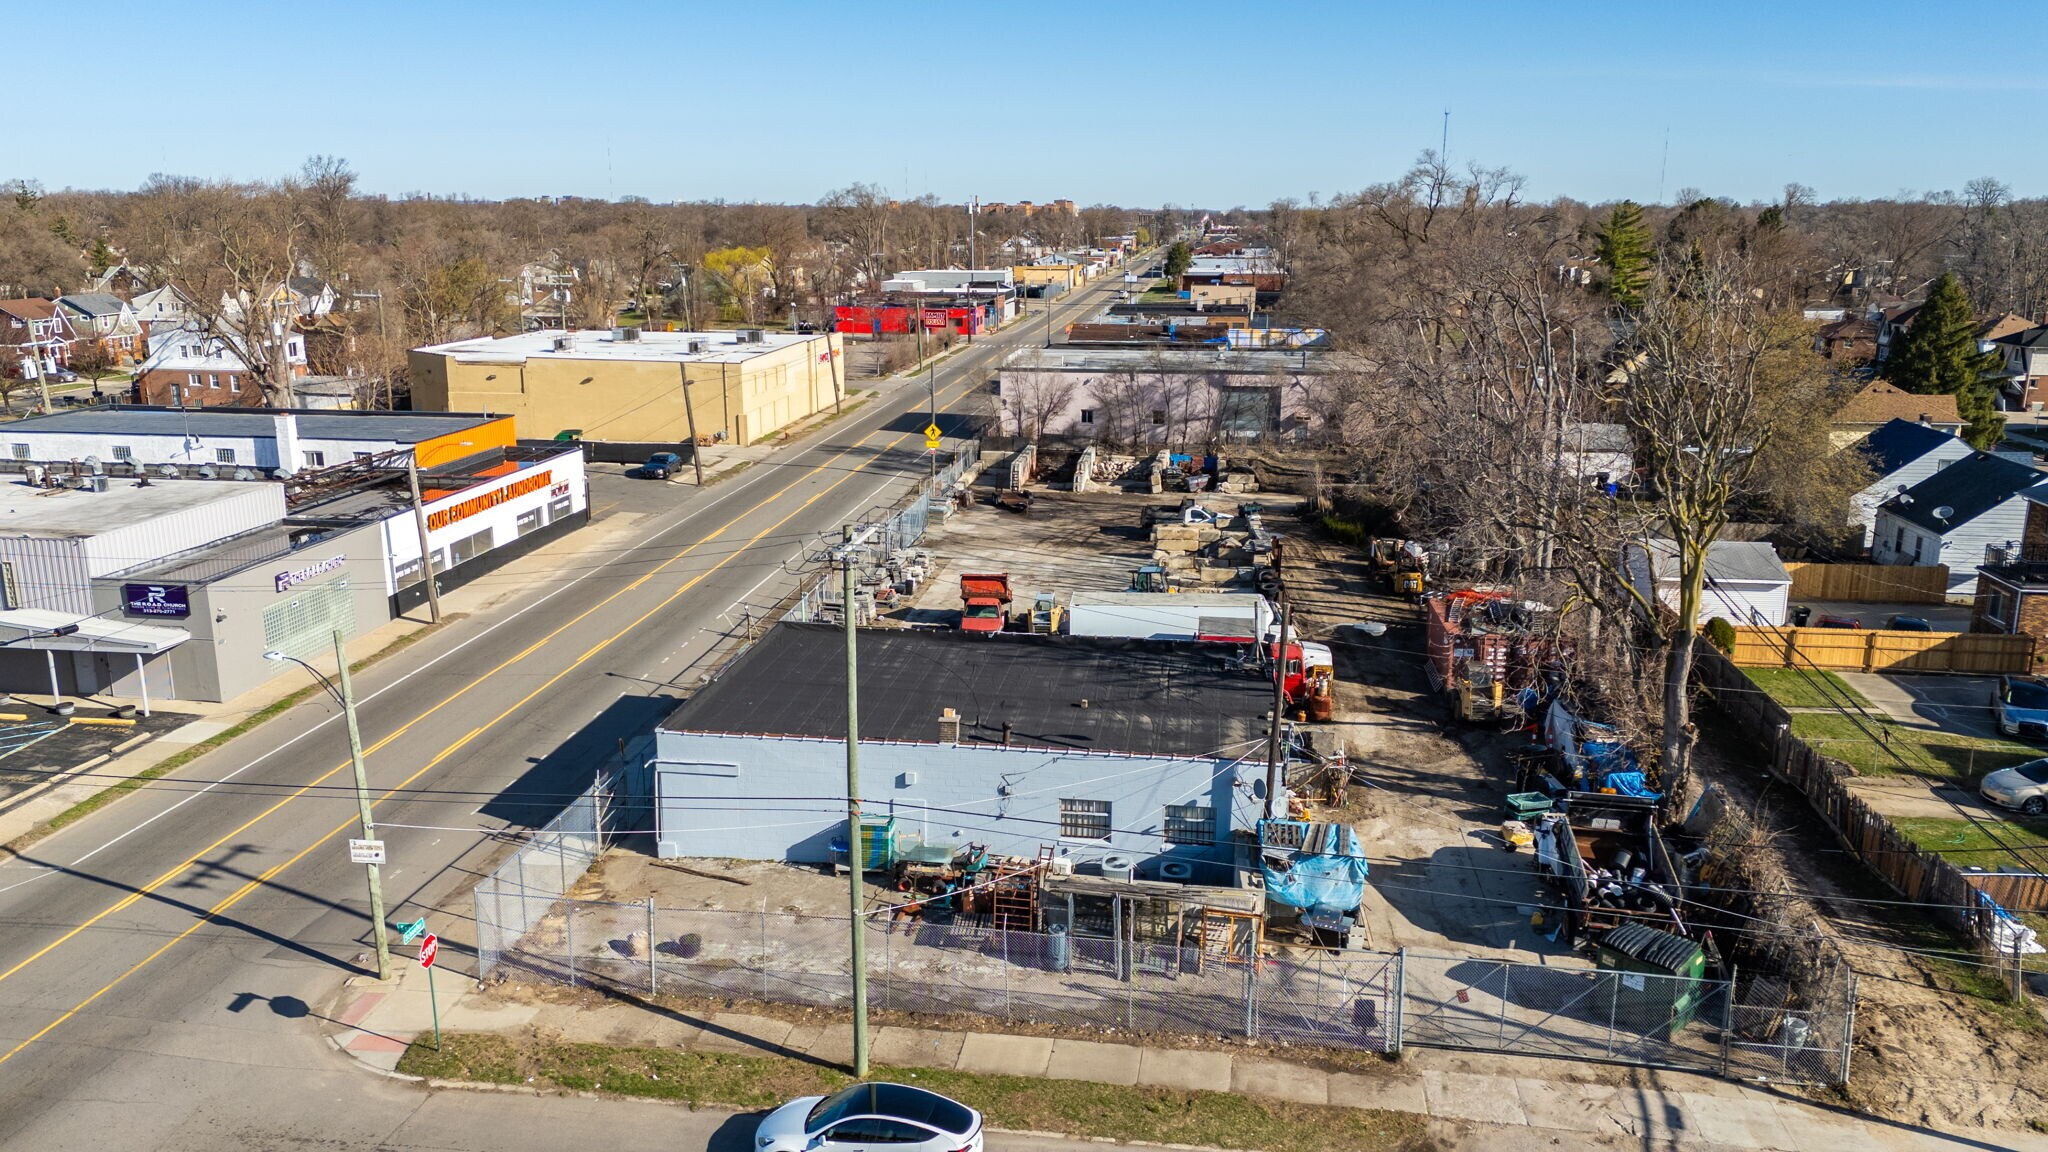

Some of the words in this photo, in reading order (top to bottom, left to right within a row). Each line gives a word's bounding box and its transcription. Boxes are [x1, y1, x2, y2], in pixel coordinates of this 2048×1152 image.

[428, 507, 450, 532] OUR
[449, 487, 503, 522] COMMUNITY
[502, 470, 552, 503] LAUNDROMAT
[290, 571, 304, 585] THE
[323, 554, 346, 572] CHURCH
[421, 939, 436, 963] STOP
